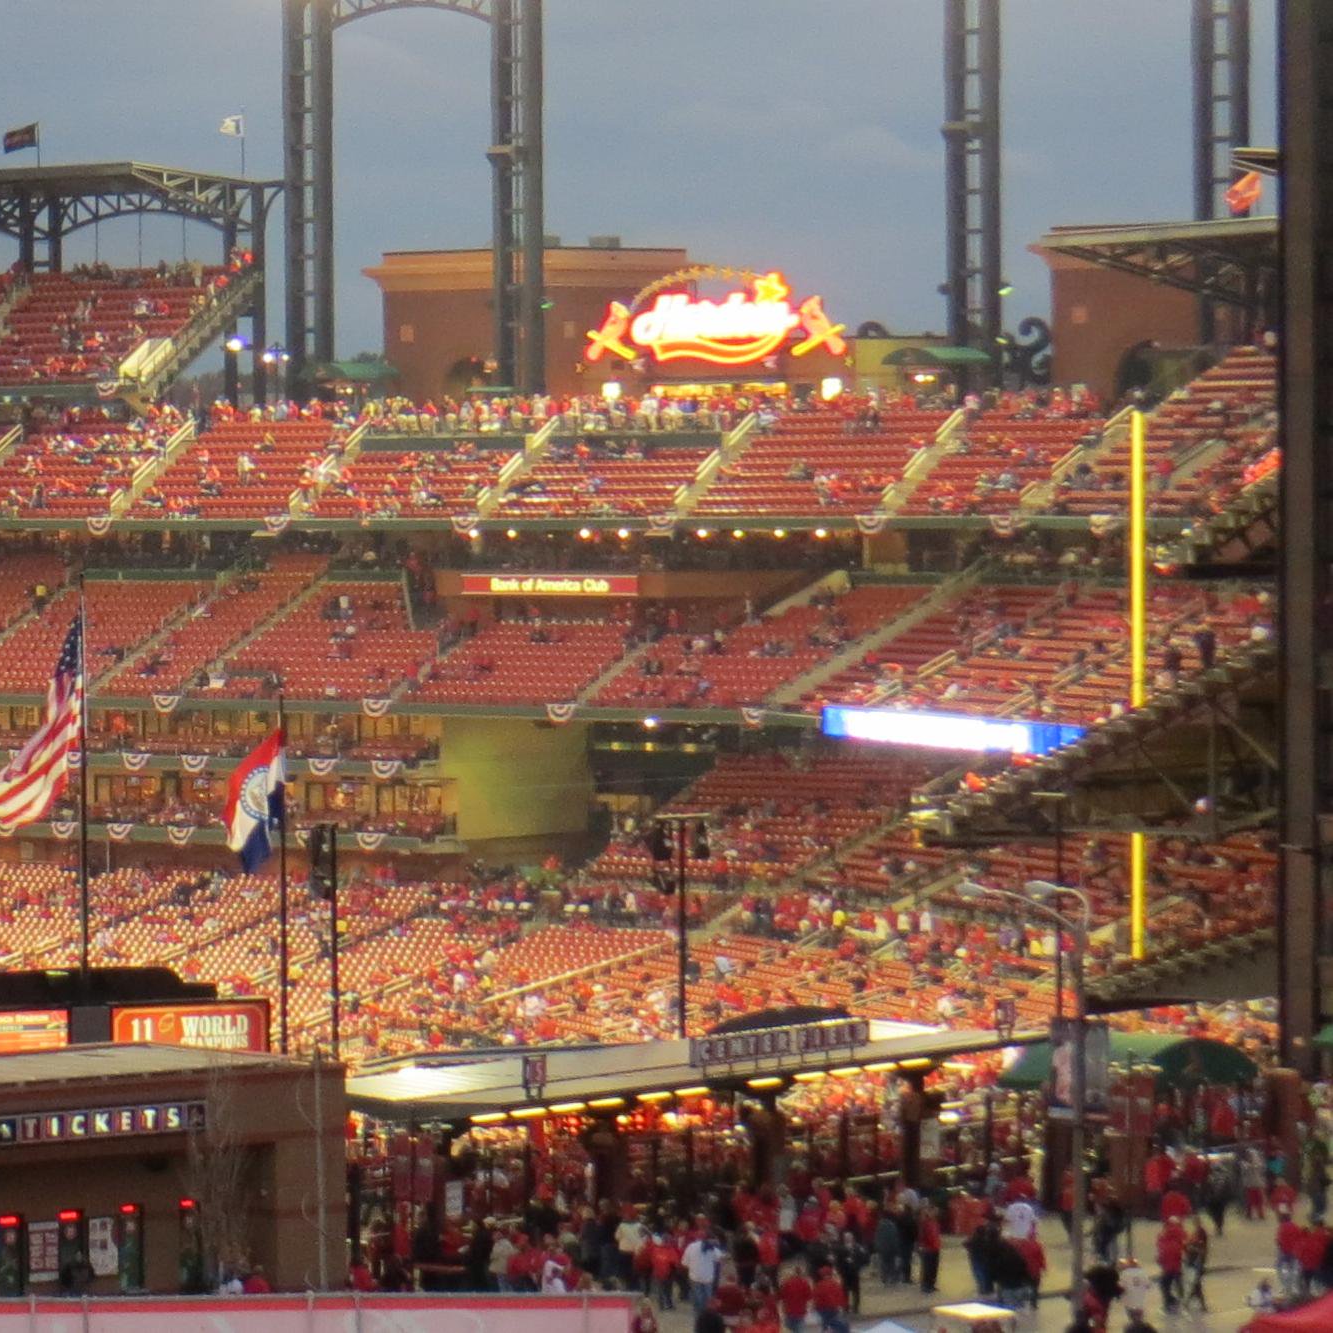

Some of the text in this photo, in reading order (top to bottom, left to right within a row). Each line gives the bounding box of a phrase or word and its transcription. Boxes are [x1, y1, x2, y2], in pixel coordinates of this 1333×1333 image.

[490, 576, 610, 593] Bank of America Club
[131, 1017, 153, 1042] 11
[180, 1014, 249, 1036] WORLD
[22, 1107, 181, 1139] TICKETS
